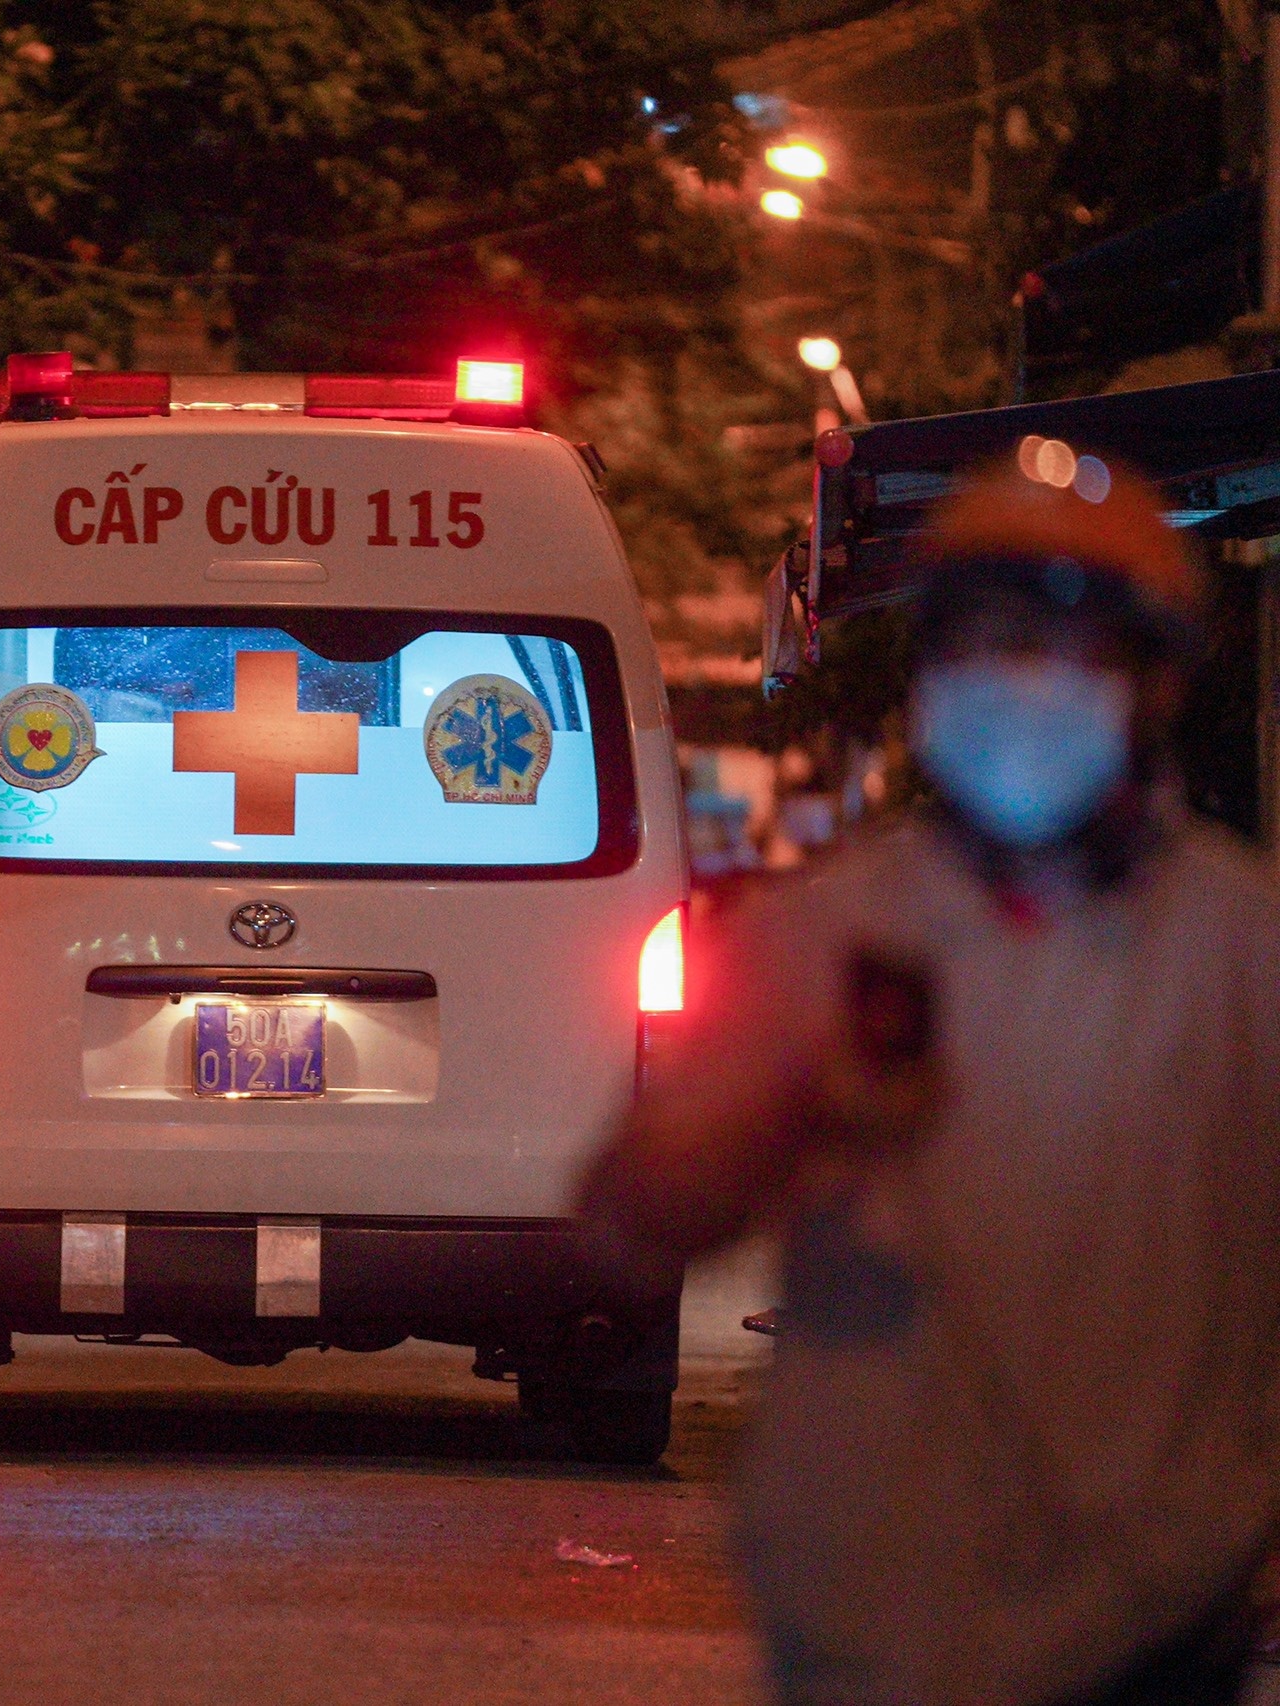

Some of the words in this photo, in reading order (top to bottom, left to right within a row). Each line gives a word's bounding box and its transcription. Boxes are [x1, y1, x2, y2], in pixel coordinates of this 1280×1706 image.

[54, 463, 184, 546] CẤP
[205, 468, 336, 546] CỨU
[367, 489, 485, 549] 115
[226, 1007, 292, 1047] 50A
[200, 1048, 320, 1091] 012.14
